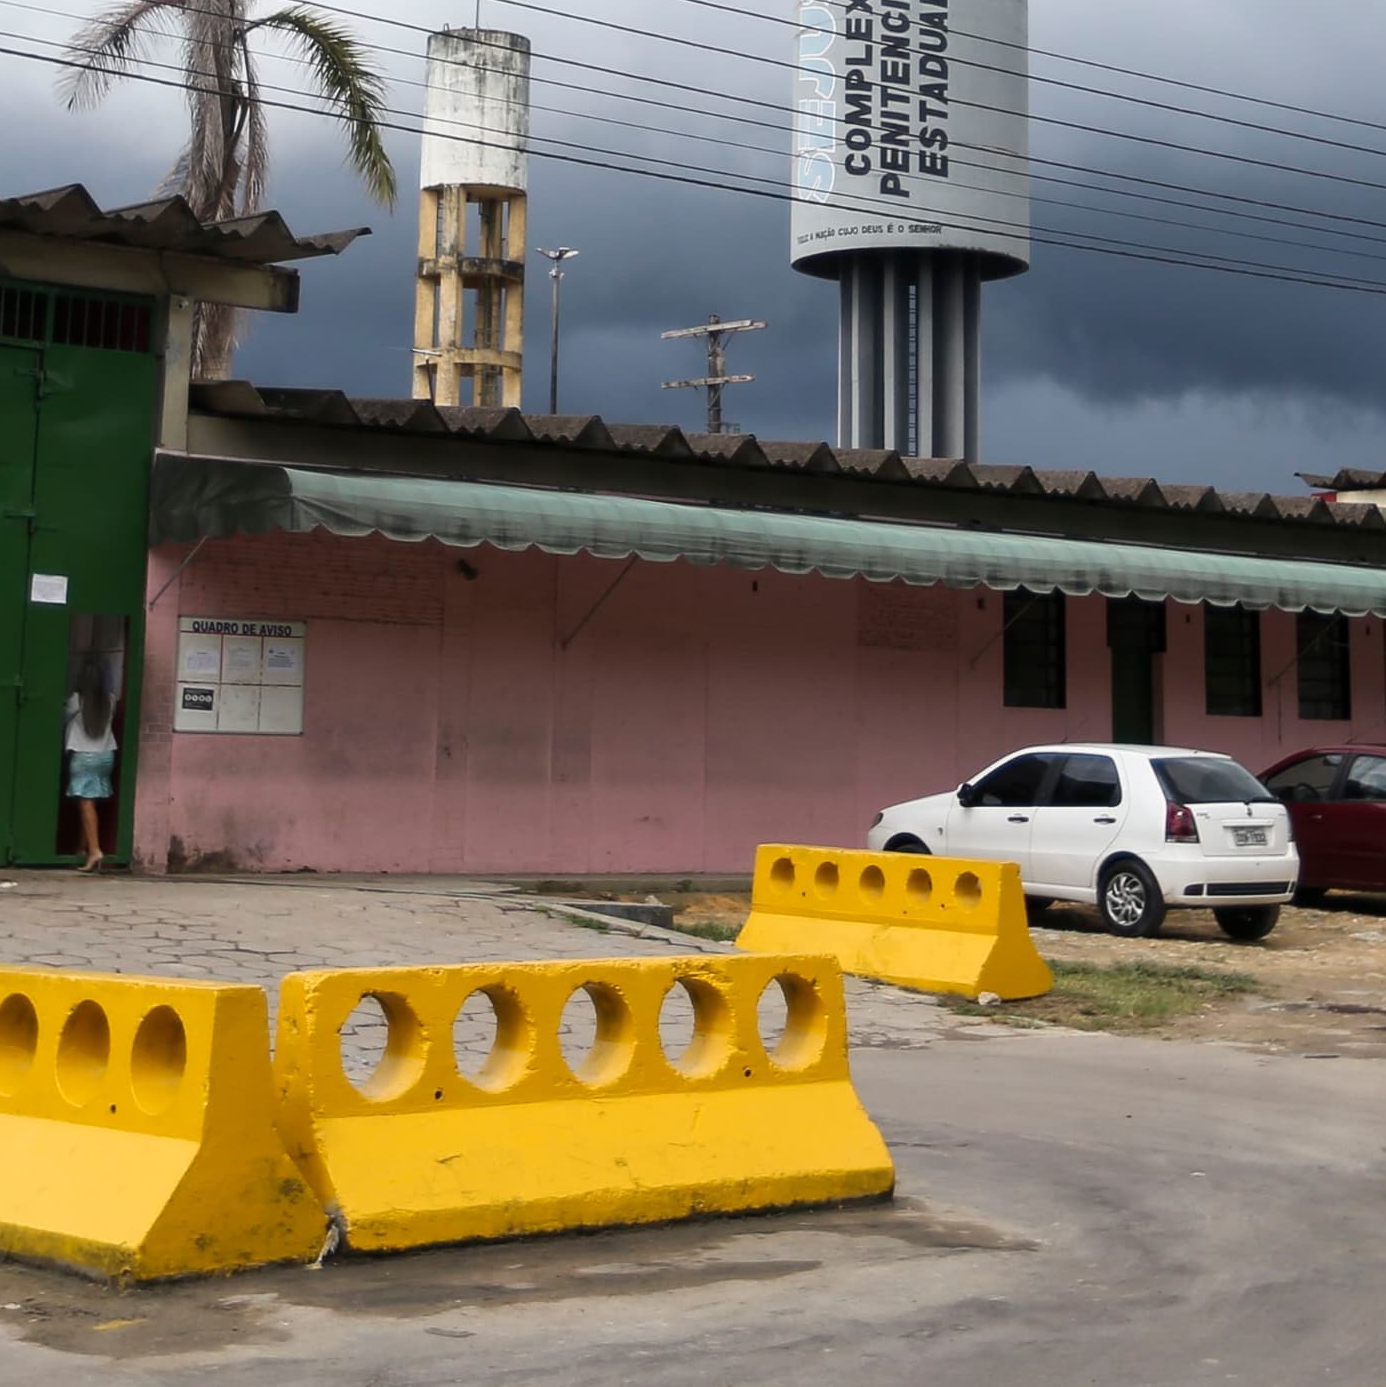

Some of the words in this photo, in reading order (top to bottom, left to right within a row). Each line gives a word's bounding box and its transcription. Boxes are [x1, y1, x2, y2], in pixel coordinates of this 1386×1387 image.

[838, 226, 859, 236] CUJO
[862, 224, 883, 234] DEUS
[898, 224, 904, 233] O
[192, 620, 239, 634] QUADRO
[242, 624, 257, 635] DE
[259, 625, 292, 636] AVISO
